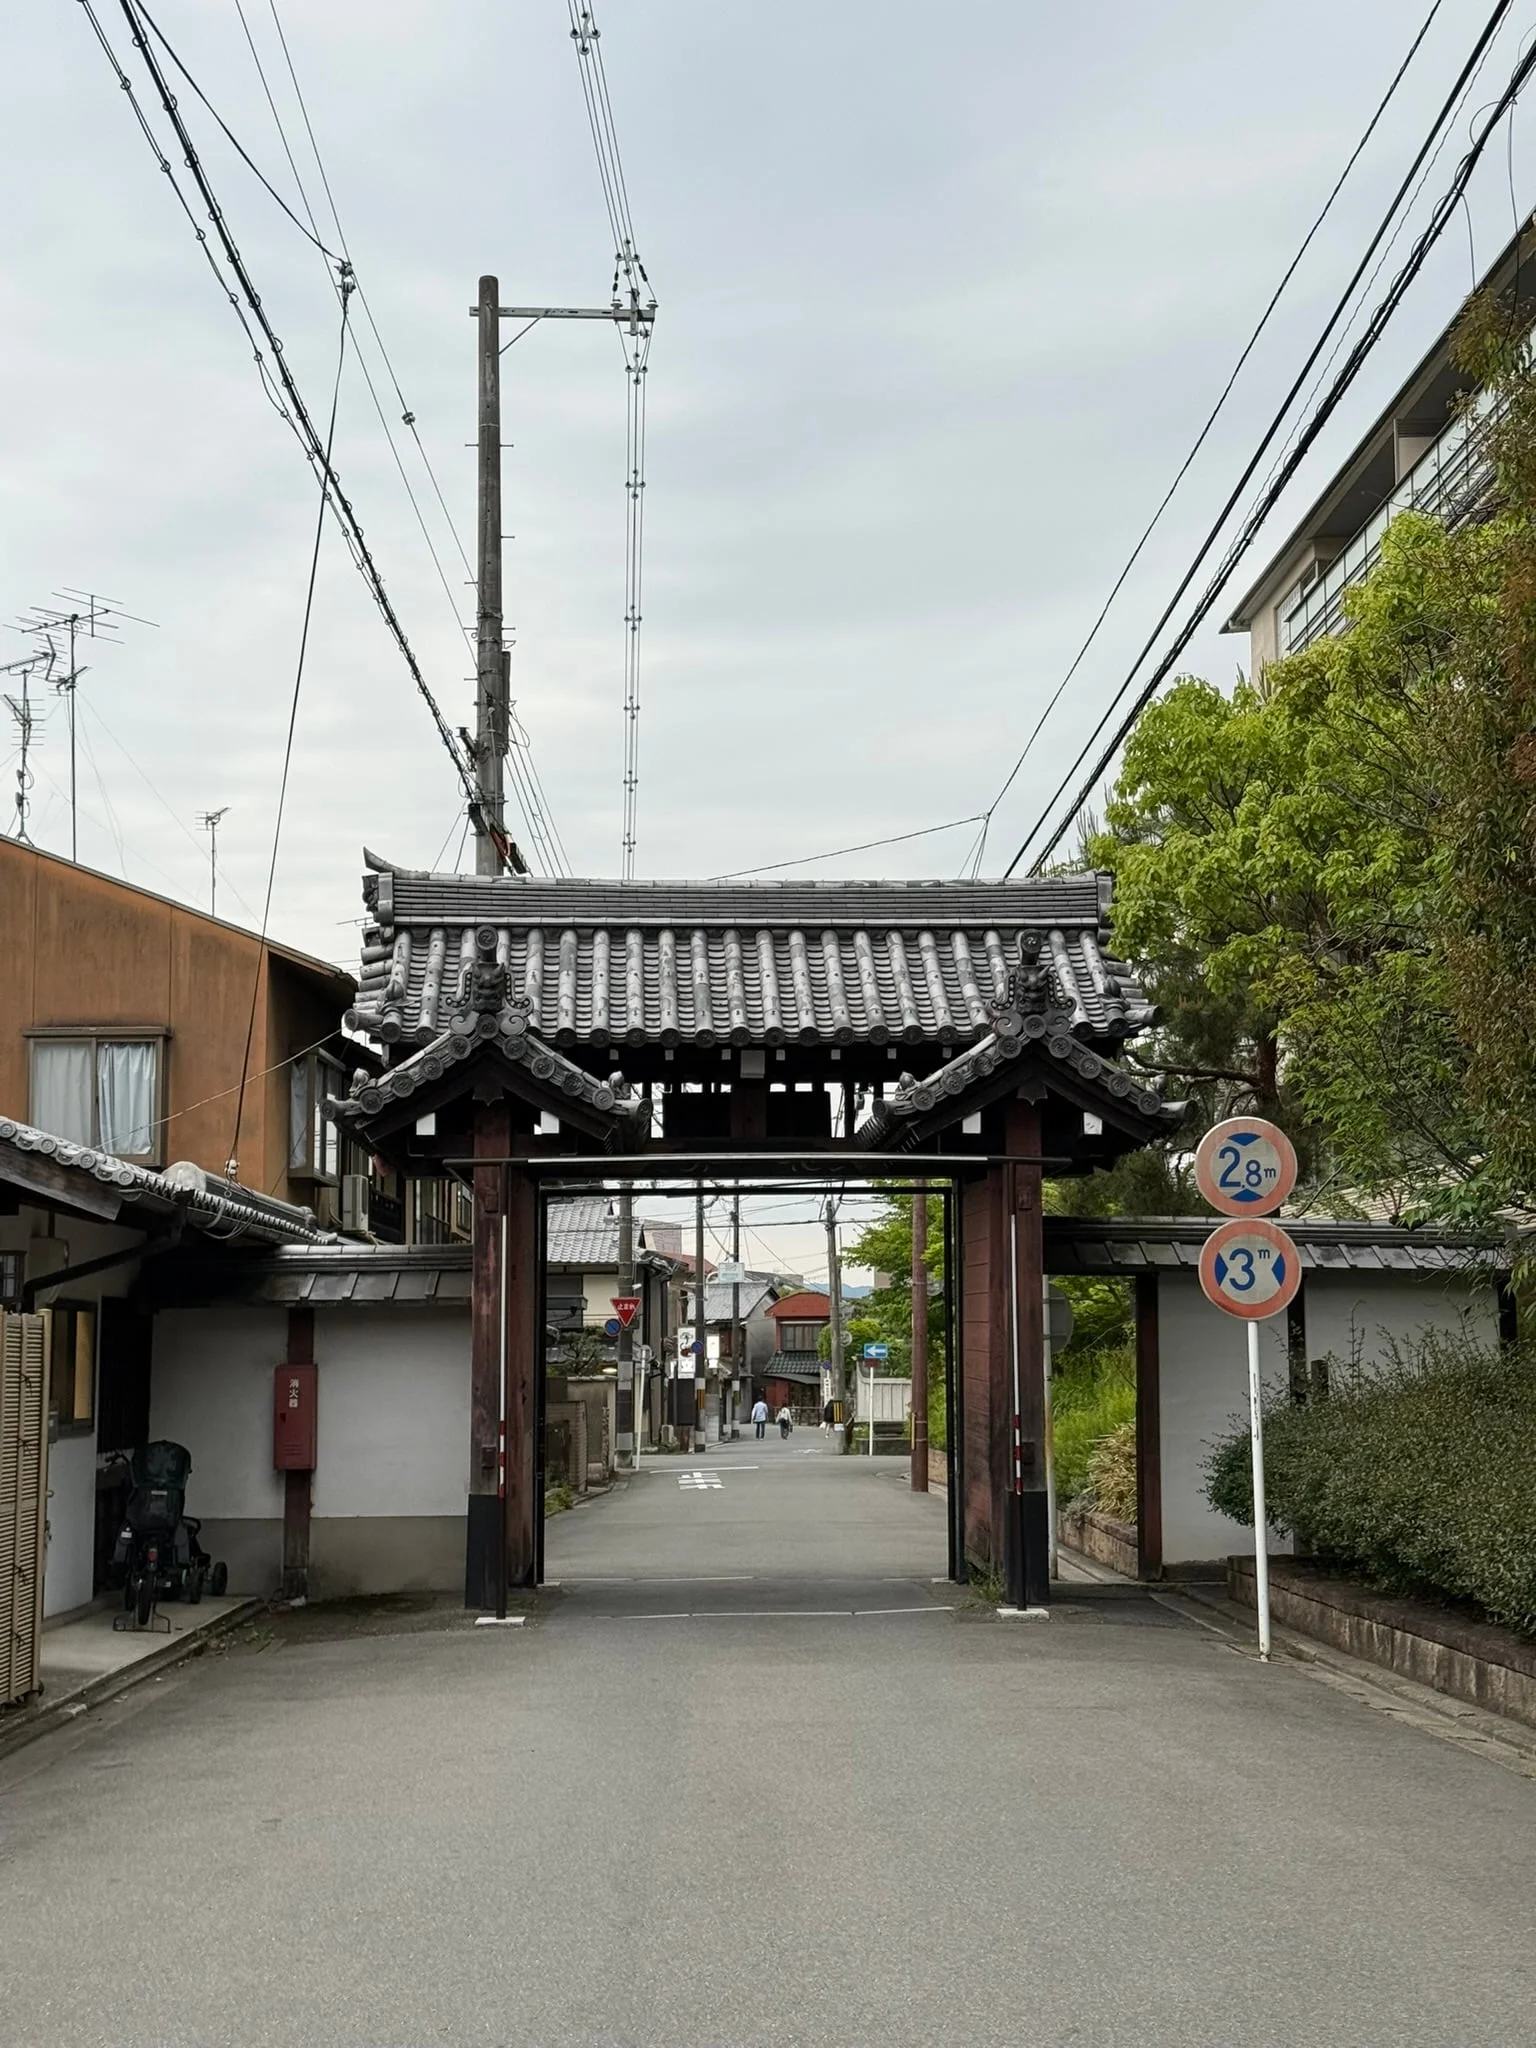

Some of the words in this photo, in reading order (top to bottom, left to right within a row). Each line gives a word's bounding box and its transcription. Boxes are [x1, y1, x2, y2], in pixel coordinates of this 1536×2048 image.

[617, 1303, 635, 1311] 止まれ
[288, 1378, 299, 1408] 消火器
